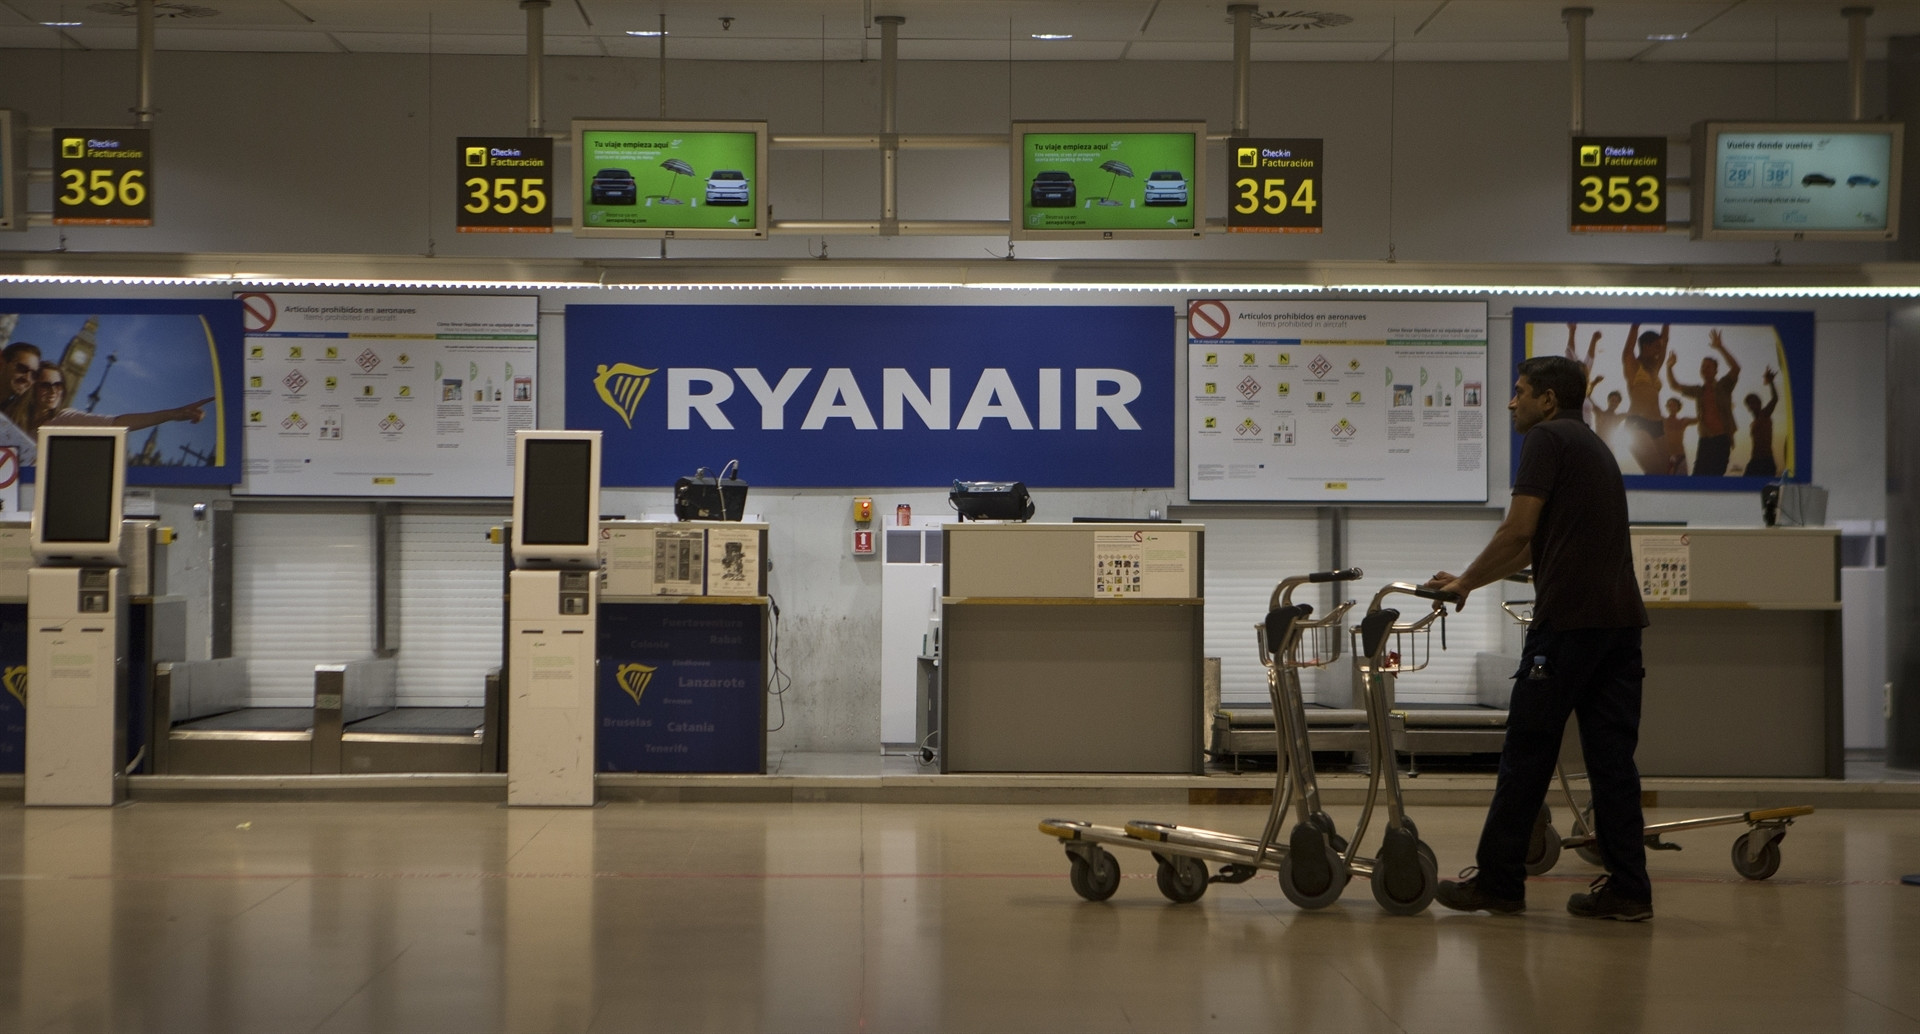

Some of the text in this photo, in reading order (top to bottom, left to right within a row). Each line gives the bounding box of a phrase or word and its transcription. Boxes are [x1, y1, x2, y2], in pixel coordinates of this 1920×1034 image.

[594, 141, 669, 149] Tu viaje empieza aquí
[1727, 141, 1813, 150] Vueles donde vueles
[87, 149, 143, 159] Facturación
[490, 148, 521, 157] Check-in
[1261, 149, 1291, 158] Check-in
[1604, 146, 1635, 156] Check-in
[490, 157, 544, 167] Facturación
[1261, 158, 1314, 168] Facturación
[1604, 156, 1658, 166] Facturación
[60, 168, 147, 206] 356
[463, 177, 547, 214] 355
[1234, 178, 1317, 214] 354
[1579, 176, 1661, 213] 353
[320, 306, 362, 315] prohibidos
[1238, 312, 1272, 321] Artículos
[1274, 312, 1314, 322] prohibidos
[1278, 321, 1312, 329] prohibited
[667, 367, 1142, 430] RYANAIR
[662, 618, 743, 629] Fuerteventura
[678, 677, 745, 688] Lanzarote
[603, 717, 652, 728] Bruselas
[667, 722, 715, 733] Catania
[645, 743, 689, 753] Tenerife
